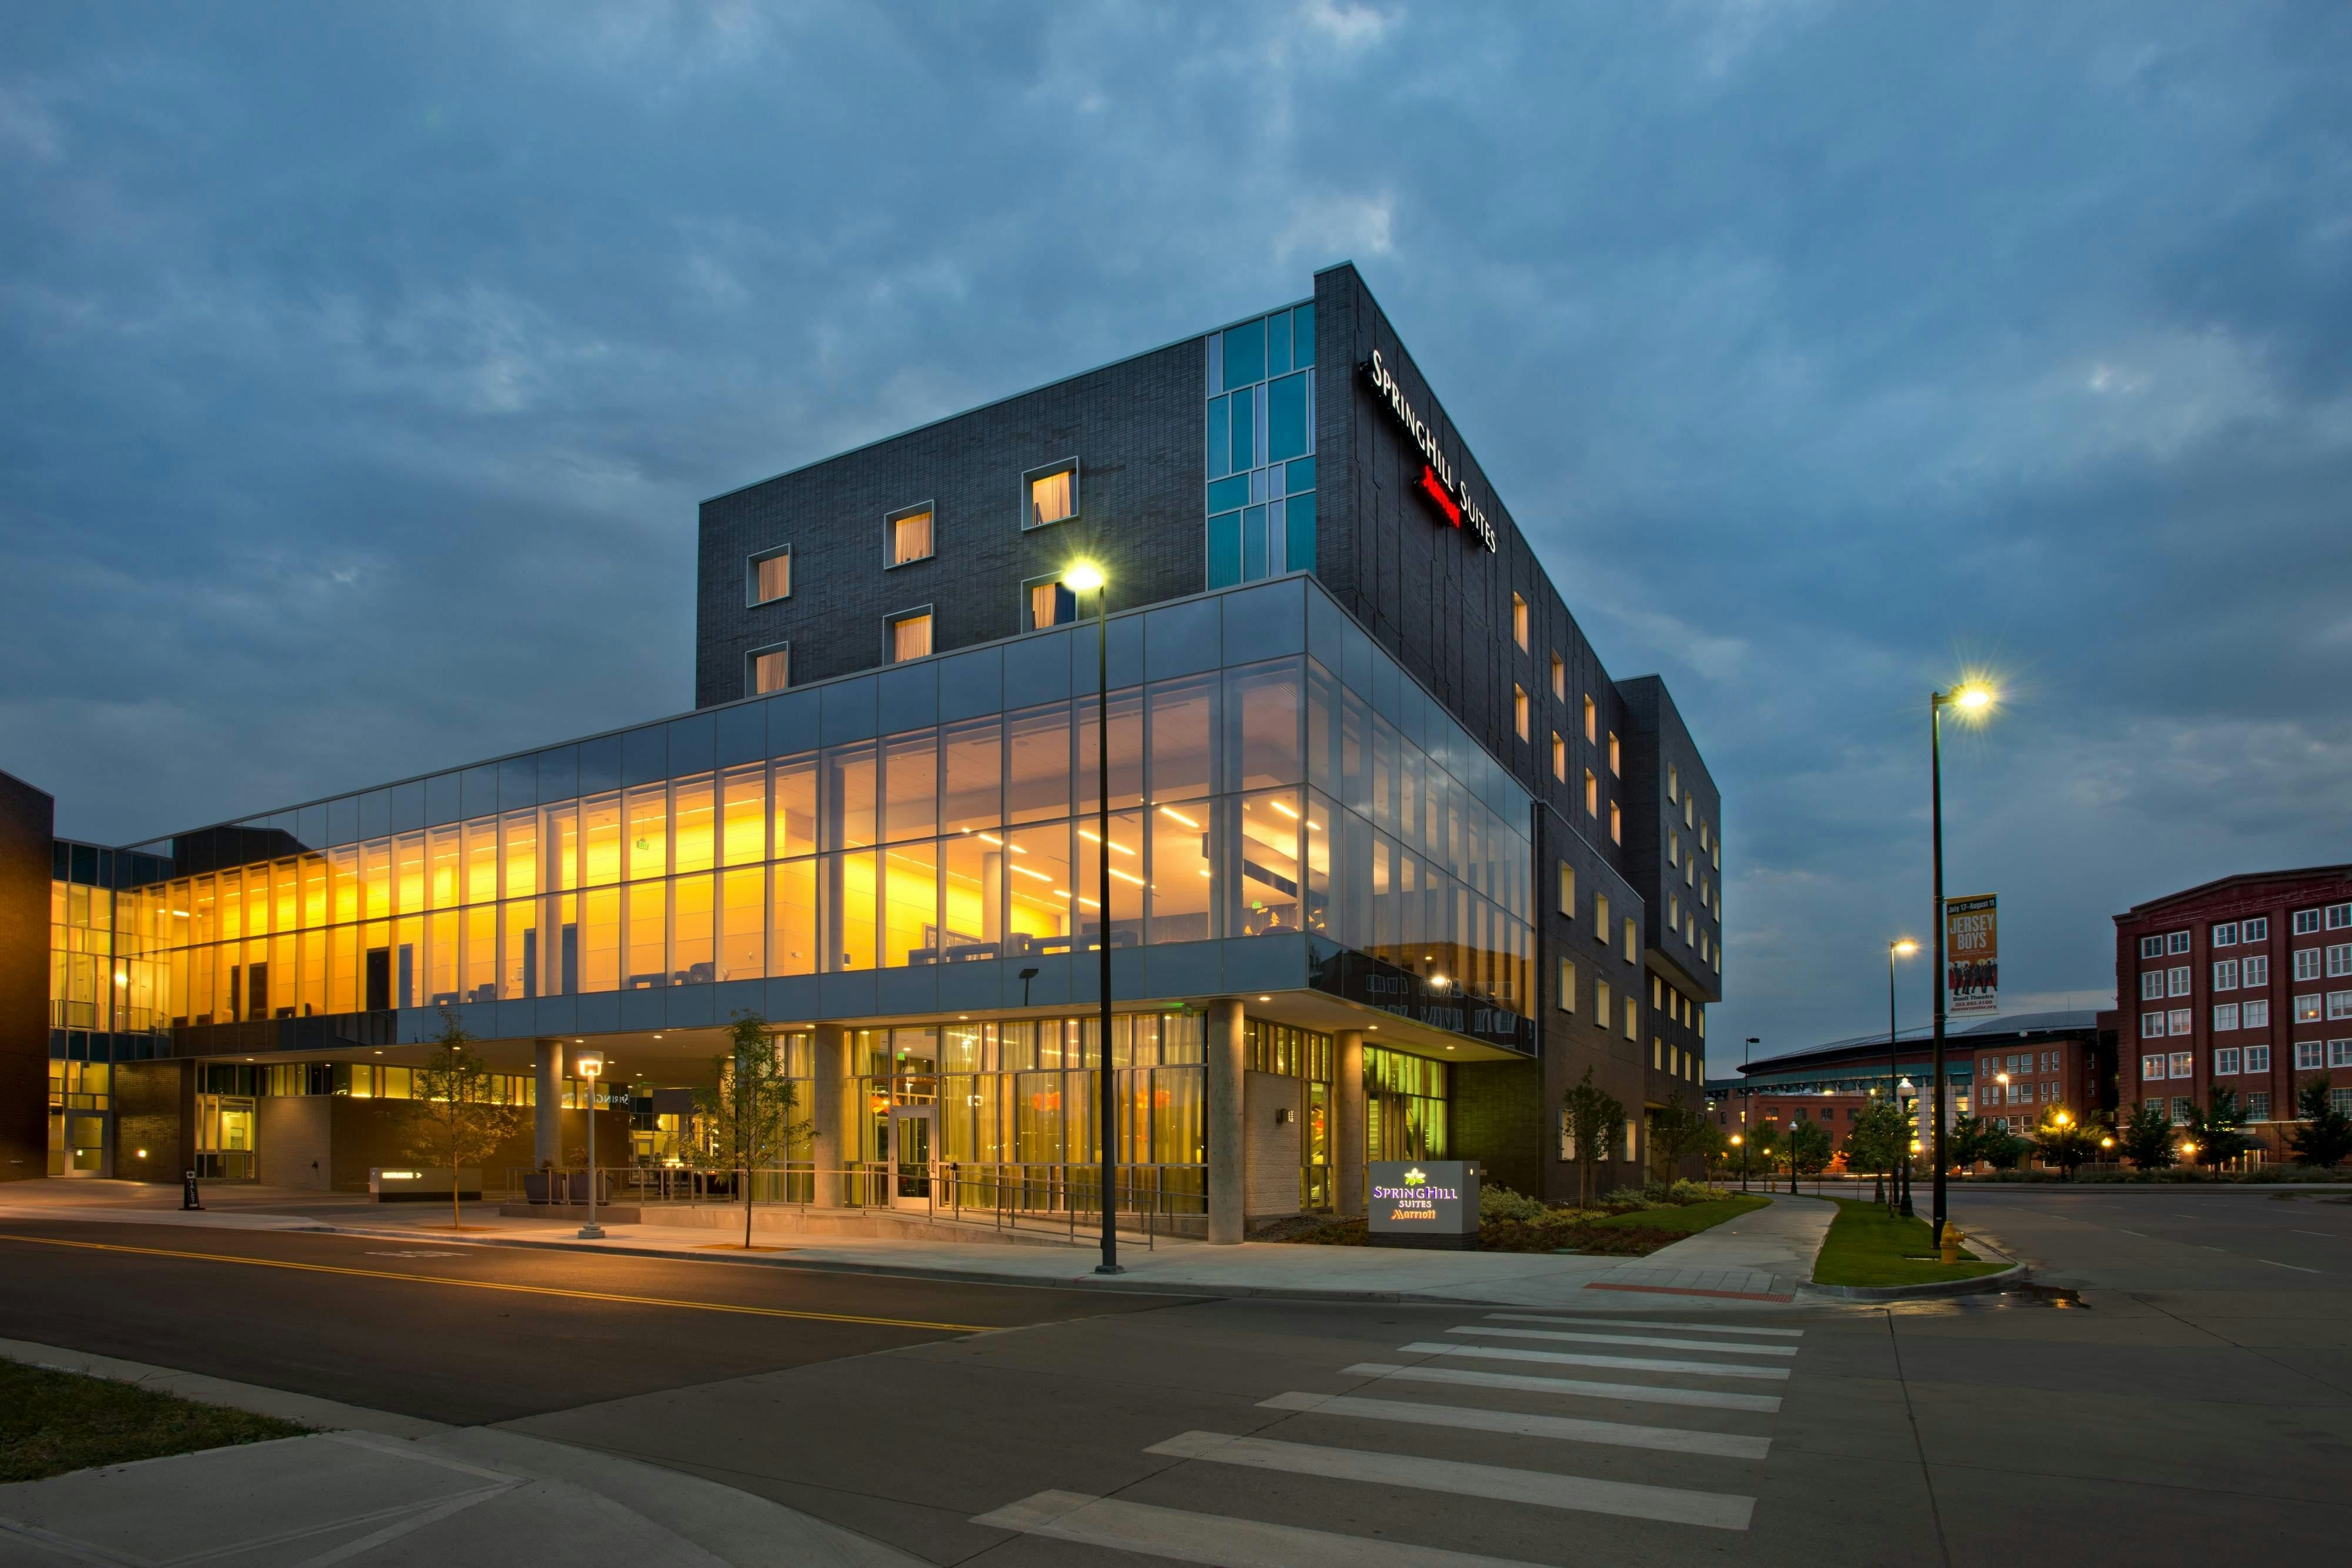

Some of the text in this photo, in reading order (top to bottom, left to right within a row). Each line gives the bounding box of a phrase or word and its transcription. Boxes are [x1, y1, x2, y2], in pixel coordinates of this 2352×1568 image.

[1372, 349, 1496, 553] SPRINGHILL SUITES
[1949, 914, 1994, 934] JERSEY
[1957, 931, 1986, 950] BOYS
[1373, 1186, 1458, 1199] SPRINGHILL
[1399, 1200, 1432, 1208] SUITES
[1391, 1209, 1436, 1220] Marriott
